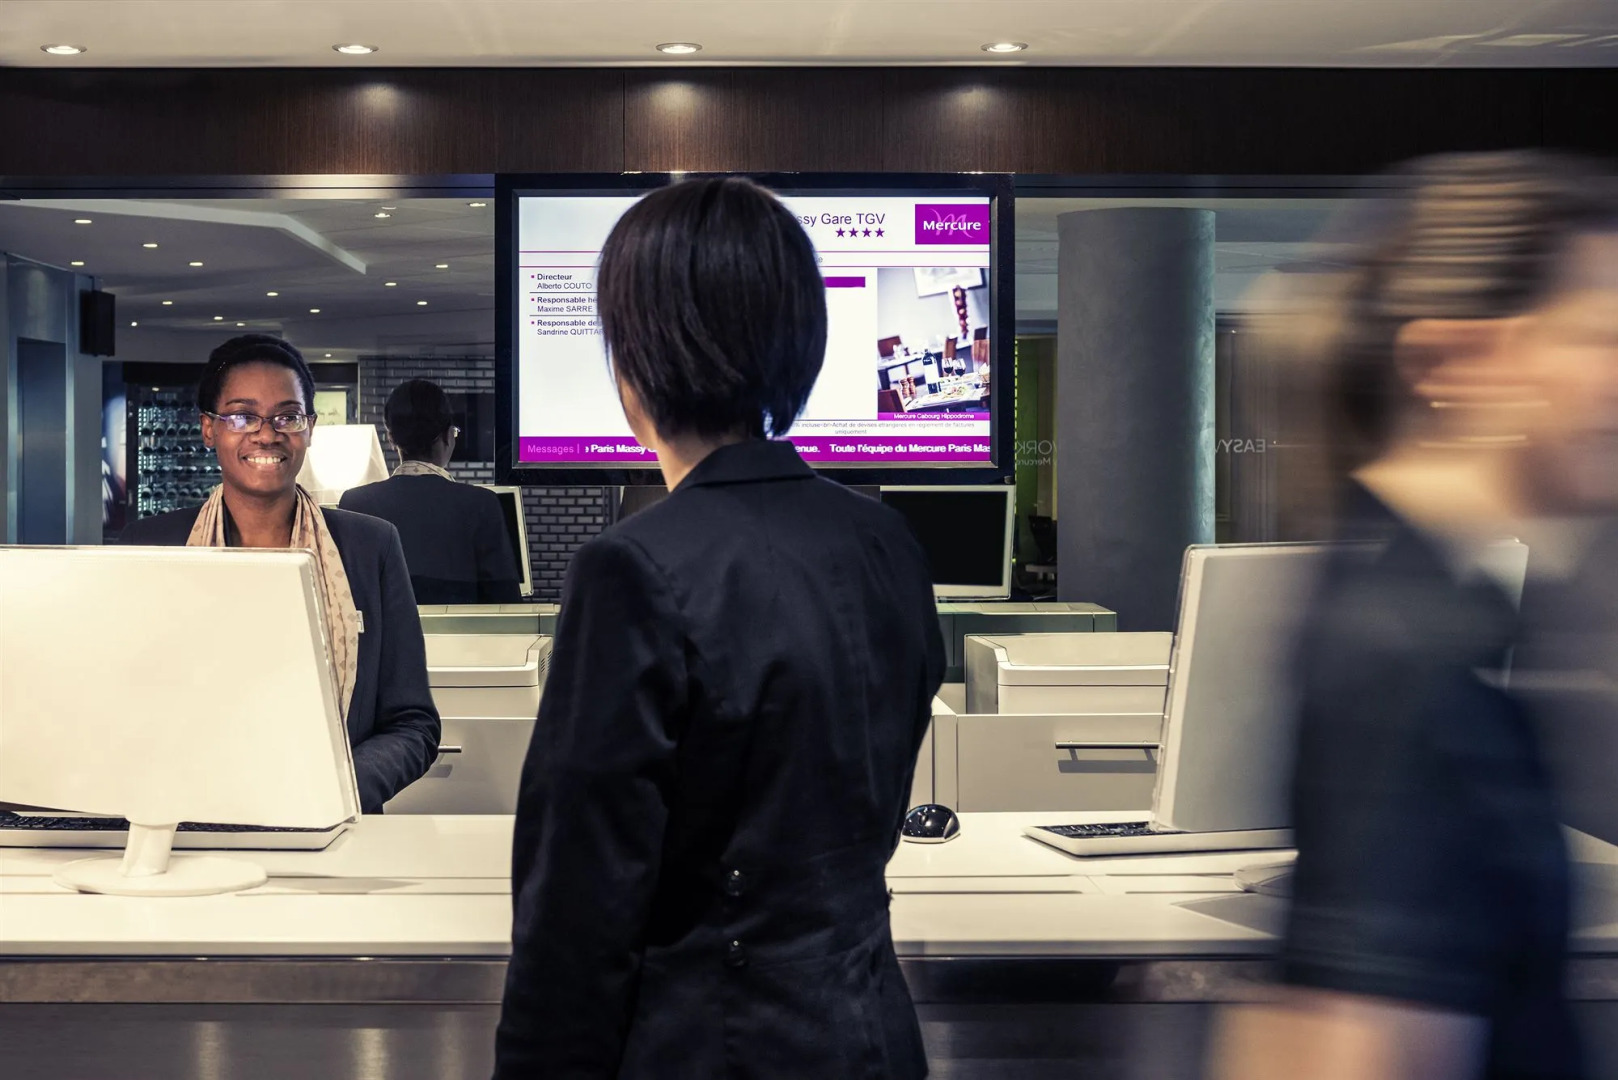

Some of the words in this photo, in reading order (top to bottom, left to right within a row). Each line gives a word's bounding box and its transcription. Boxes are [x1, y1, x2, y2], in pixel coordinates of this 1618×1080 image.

[821, 213, 852, 224] Gare
[856, 213, 886, 224] TGV
[923, 220, 982, 231] Mercure
[537, 296, 586, 304] Responsable
[537, 319, 586, 327] Responsable
[527, 444, 574, 455] Messages
[590, 444, 615, 453] Paris
[616, 444, 646, 455] Massy
[829, 444, 857, 452] Toute
[858, 444, 893, 454] l'équipe
[895, 444, 907, 452] du
[909, 444, 947, 452] Mercure
[948, 444, 972, 452] Paris
